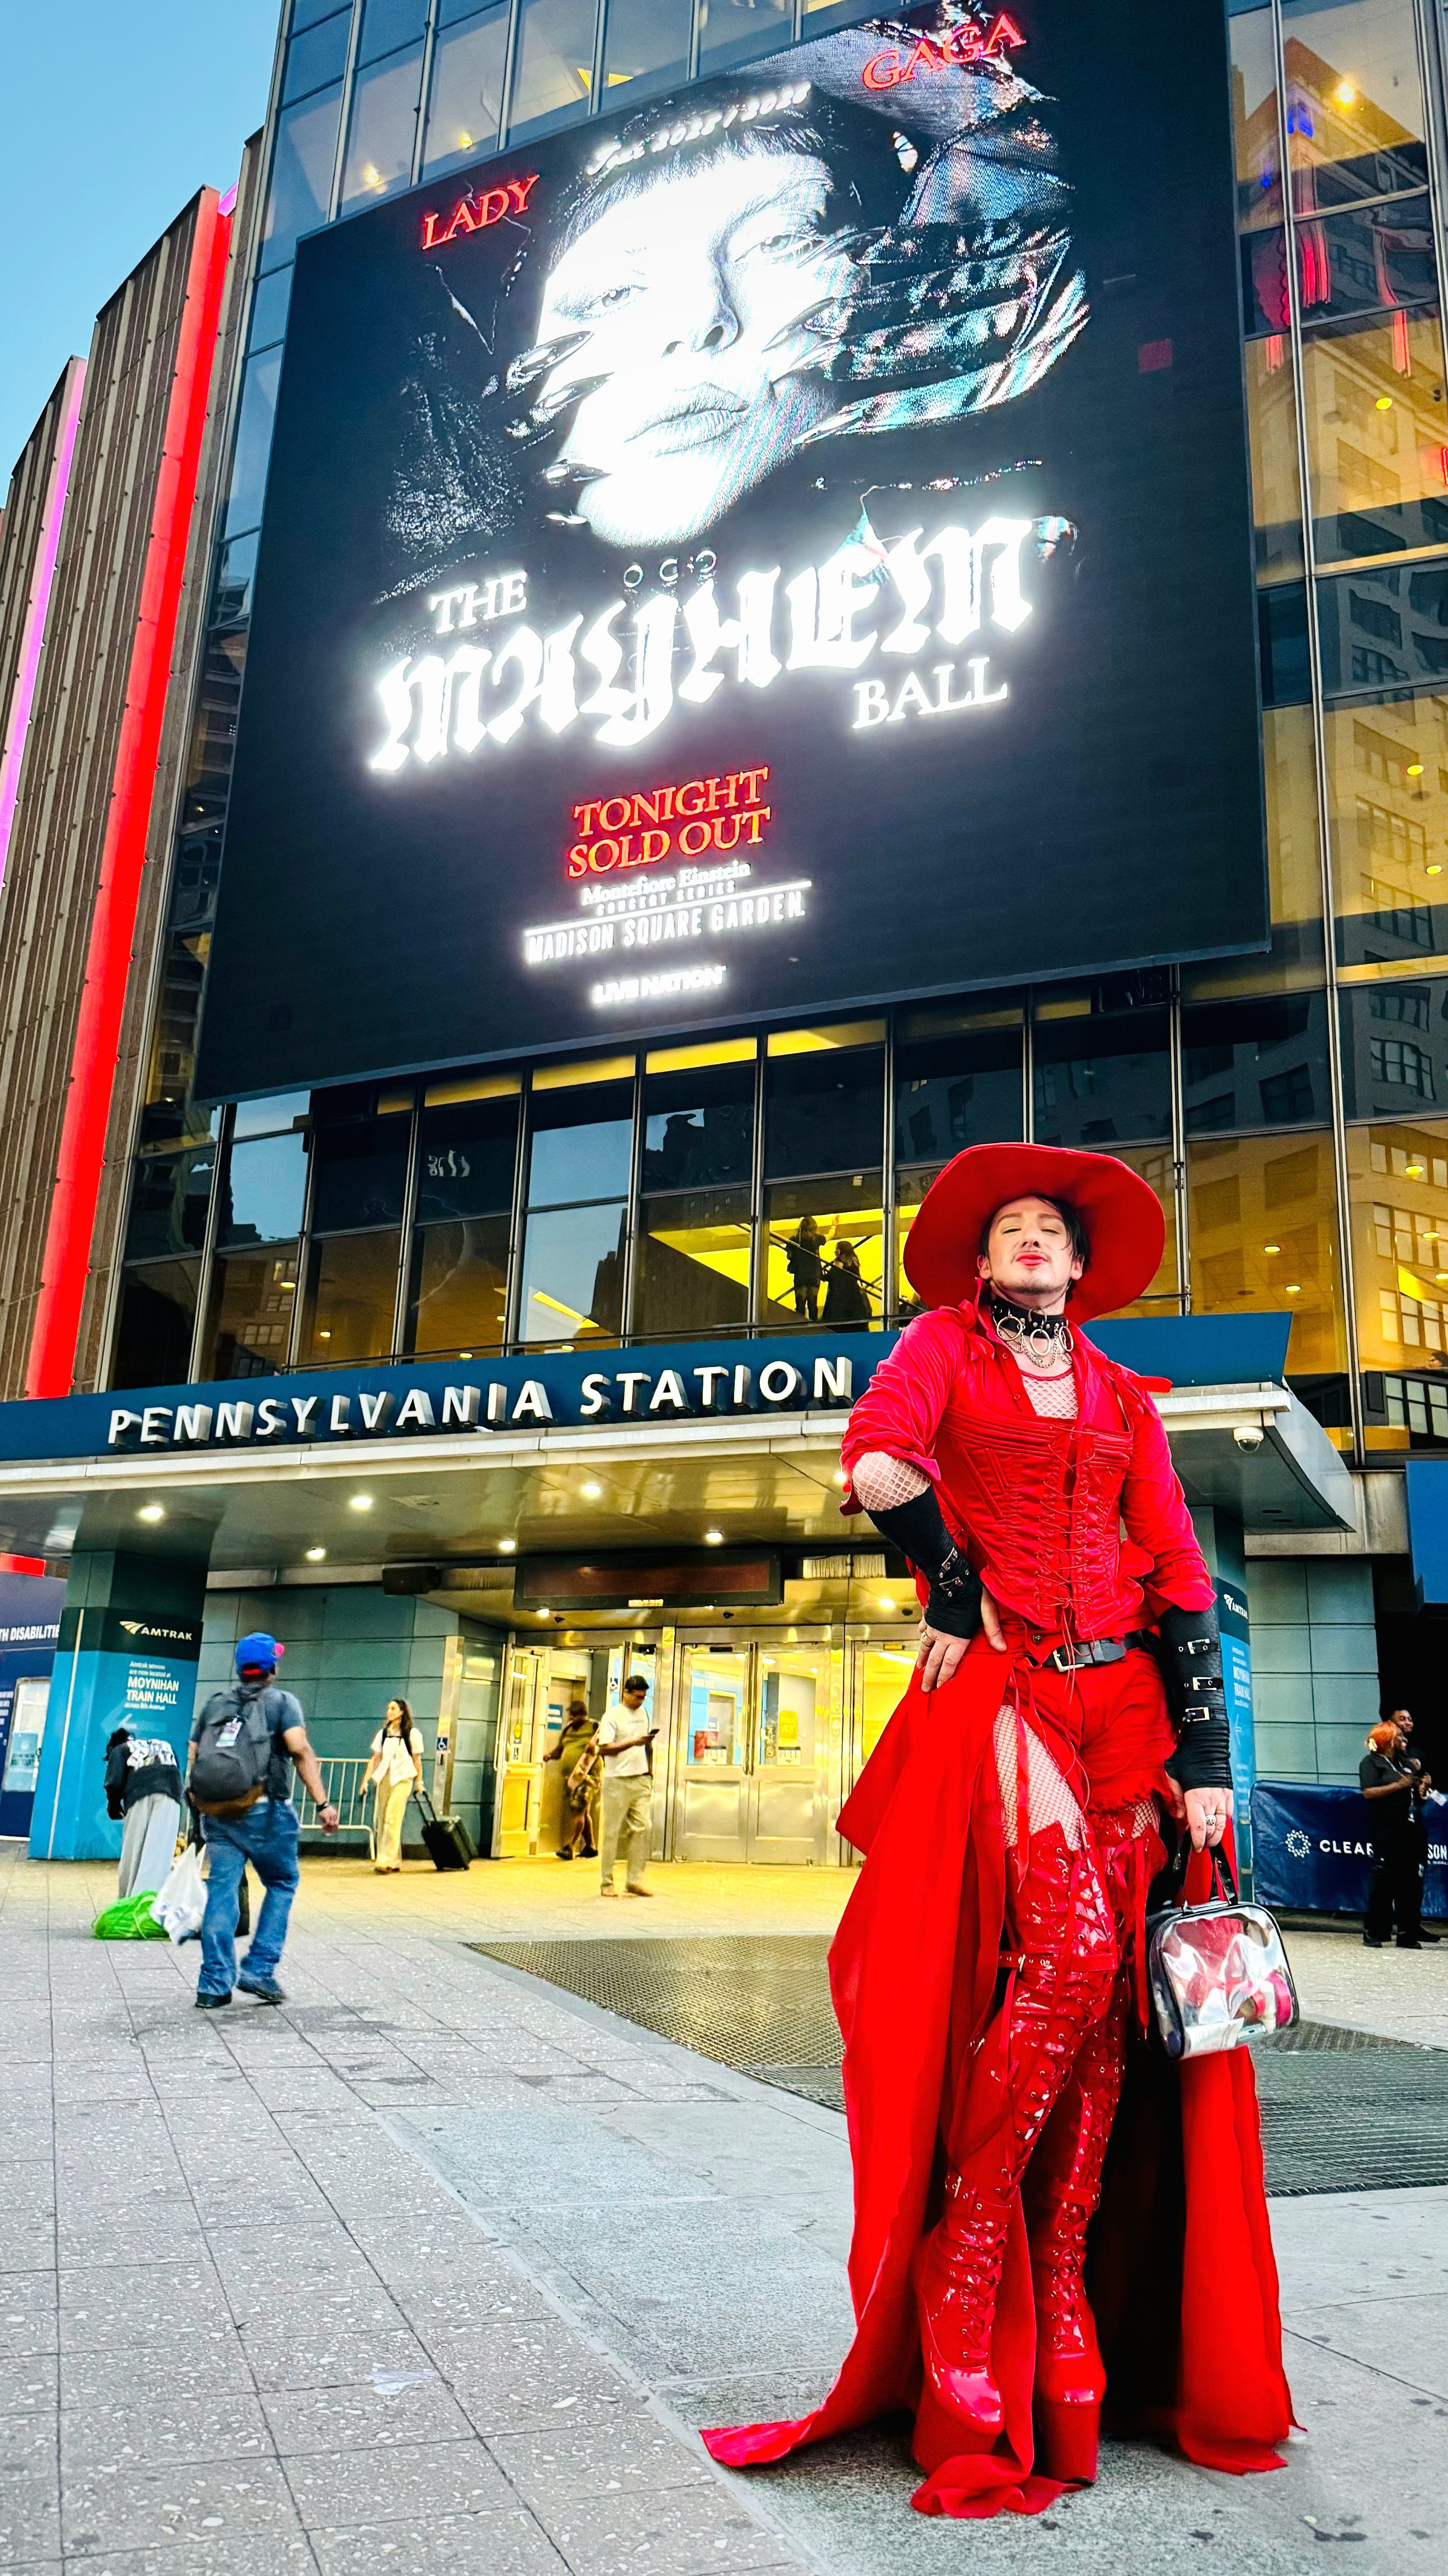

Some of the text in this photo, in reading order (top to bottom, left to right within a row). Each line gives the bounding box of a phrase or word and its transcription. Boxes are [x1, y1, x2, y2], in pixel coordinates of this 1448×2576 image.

[862, 14, 1026, 90] GAGA
[422, 174, 539, 250] LADY
[429, 569, 529, 635] THE
[371, 516, 1035, 772] MAYHEM
[852, 657, 1009, 729] BALL
[573, 766, 769, 837] TONIGHT
[568, 806, 772, 878] SOLD OUT
[582, 860, 751, 906] Montefiore Einstein
[597, 880, 736, 917] CONCERT SERIES
[528, 923, 614, 963] MADISON
[624, 907, 702, 947] SQUARE
[109, 1356, 852, 1446] PENNSYLVANIA STATION
[10, 1624, 60, 1641] DISABILITIE
[141, 1627, 193, 1641] AMTRAK
[127, 1689, 177, 1705] TRAIN HALL
[128, 1675, 179, 1692] MOYNIHAN
